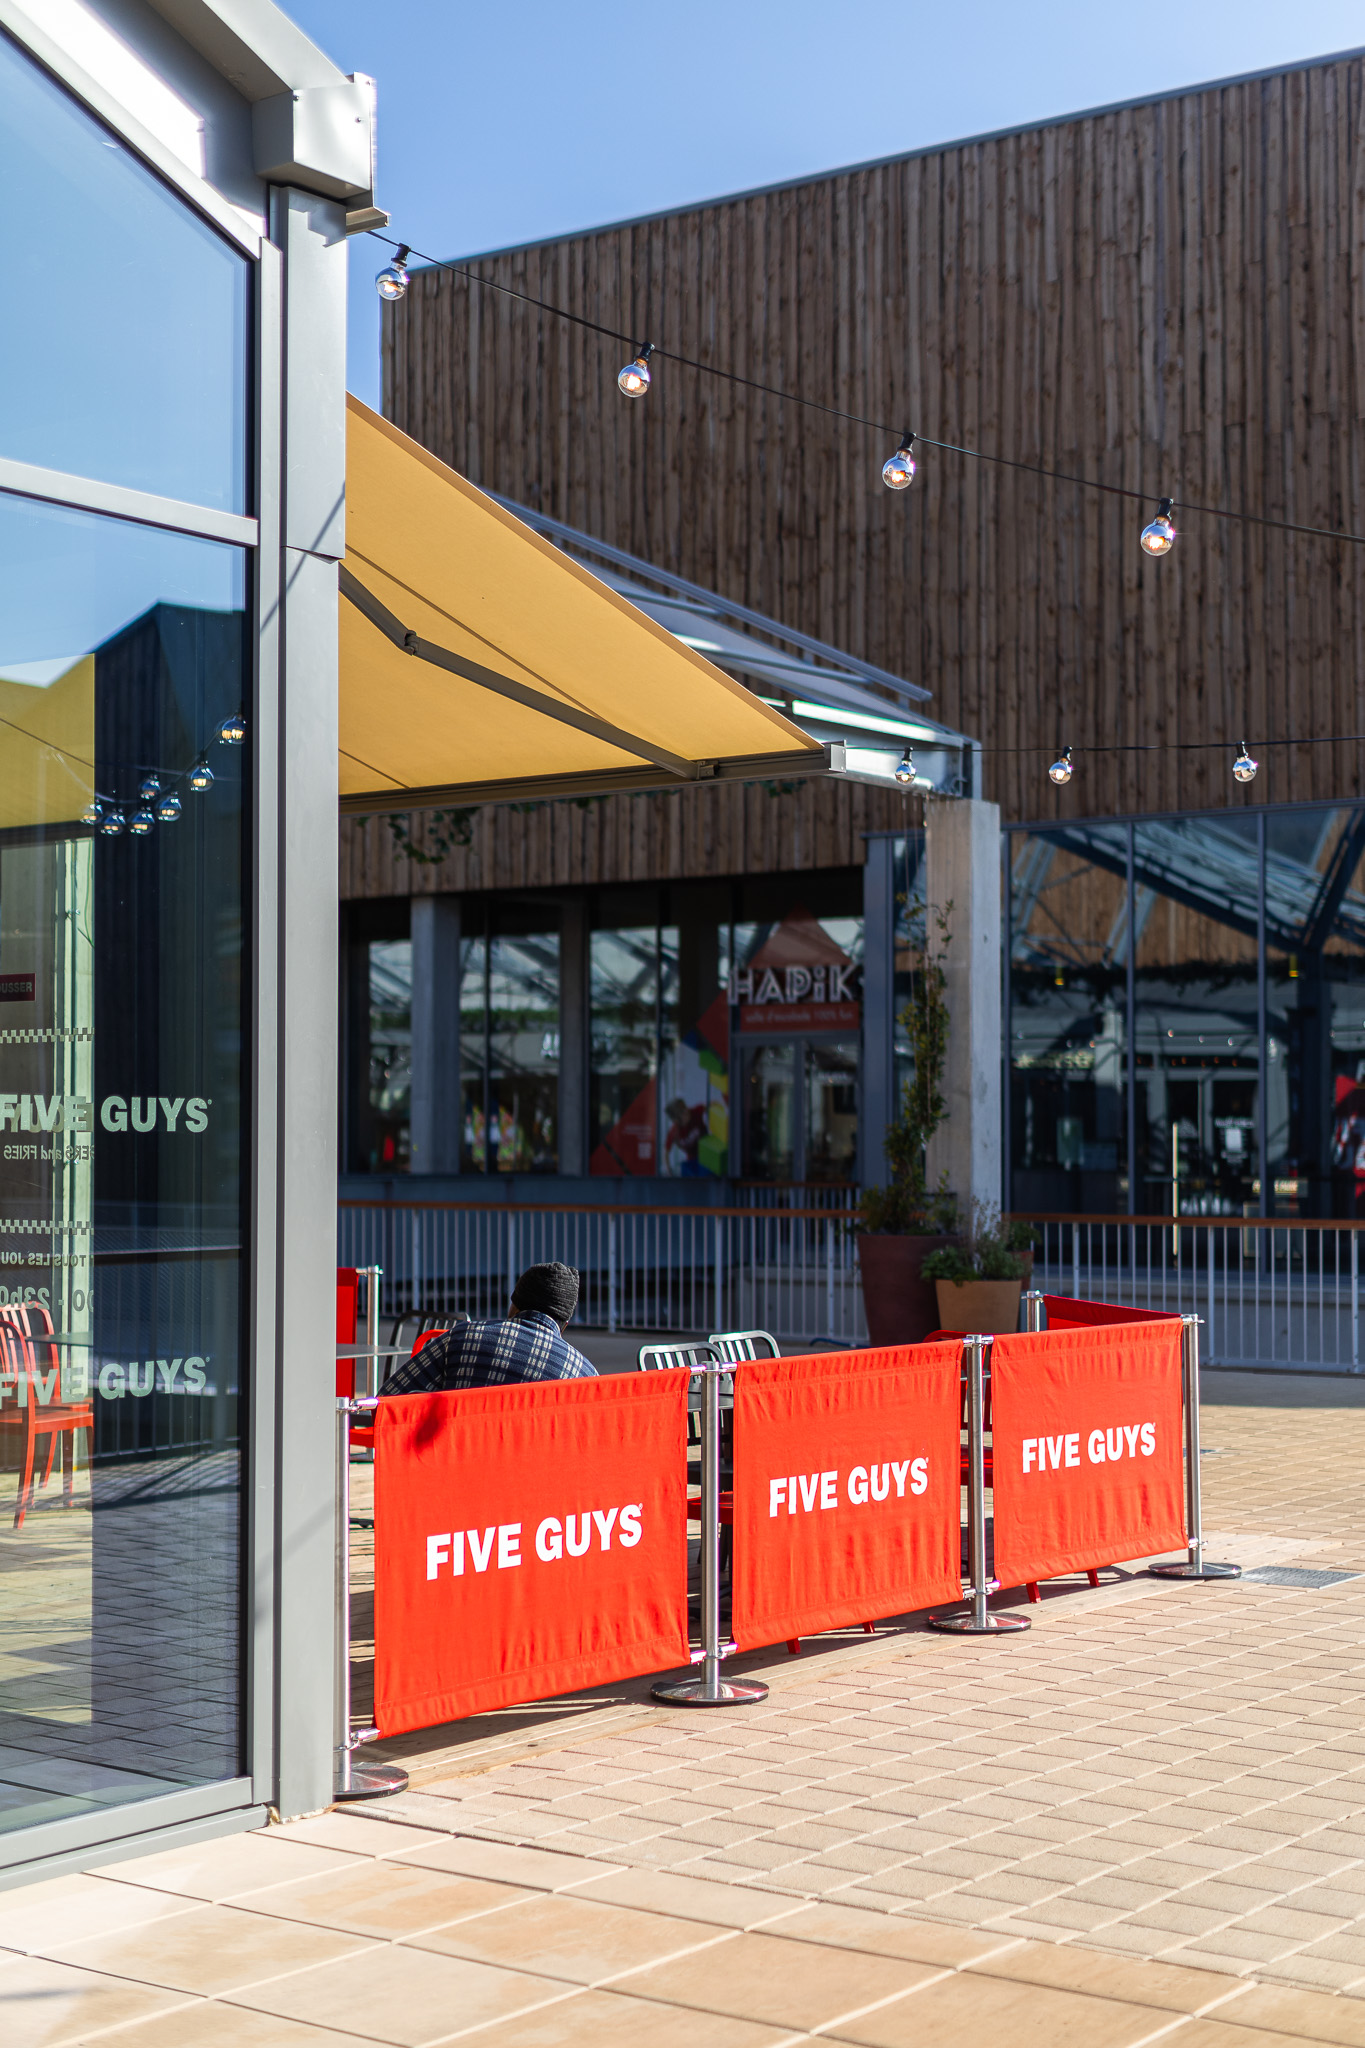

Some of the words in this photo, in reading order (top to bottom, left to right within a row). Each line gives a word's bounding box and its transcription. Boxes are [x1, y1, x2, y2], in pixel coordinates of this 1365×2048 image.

[0, 982, 32, 993] USSER
[0, 1094, 86, 1130] FIVE
[101, 1096, 209, 1132] GUYS
[0, 1368, 85, 1409] FIVE
[98, 1356, 207, 1400] GUYS
[1022, 1432, 1081, 1474] FIVE
[1087, 1422, 1156, 1464] GUYS
[769, 1470, 838, 1518] FIVE
[847, 1457, 929, 1505] GUYS
[426, 1522, 522, 1581] FIVE
[535, 1503, 643, 1562] GUYS
